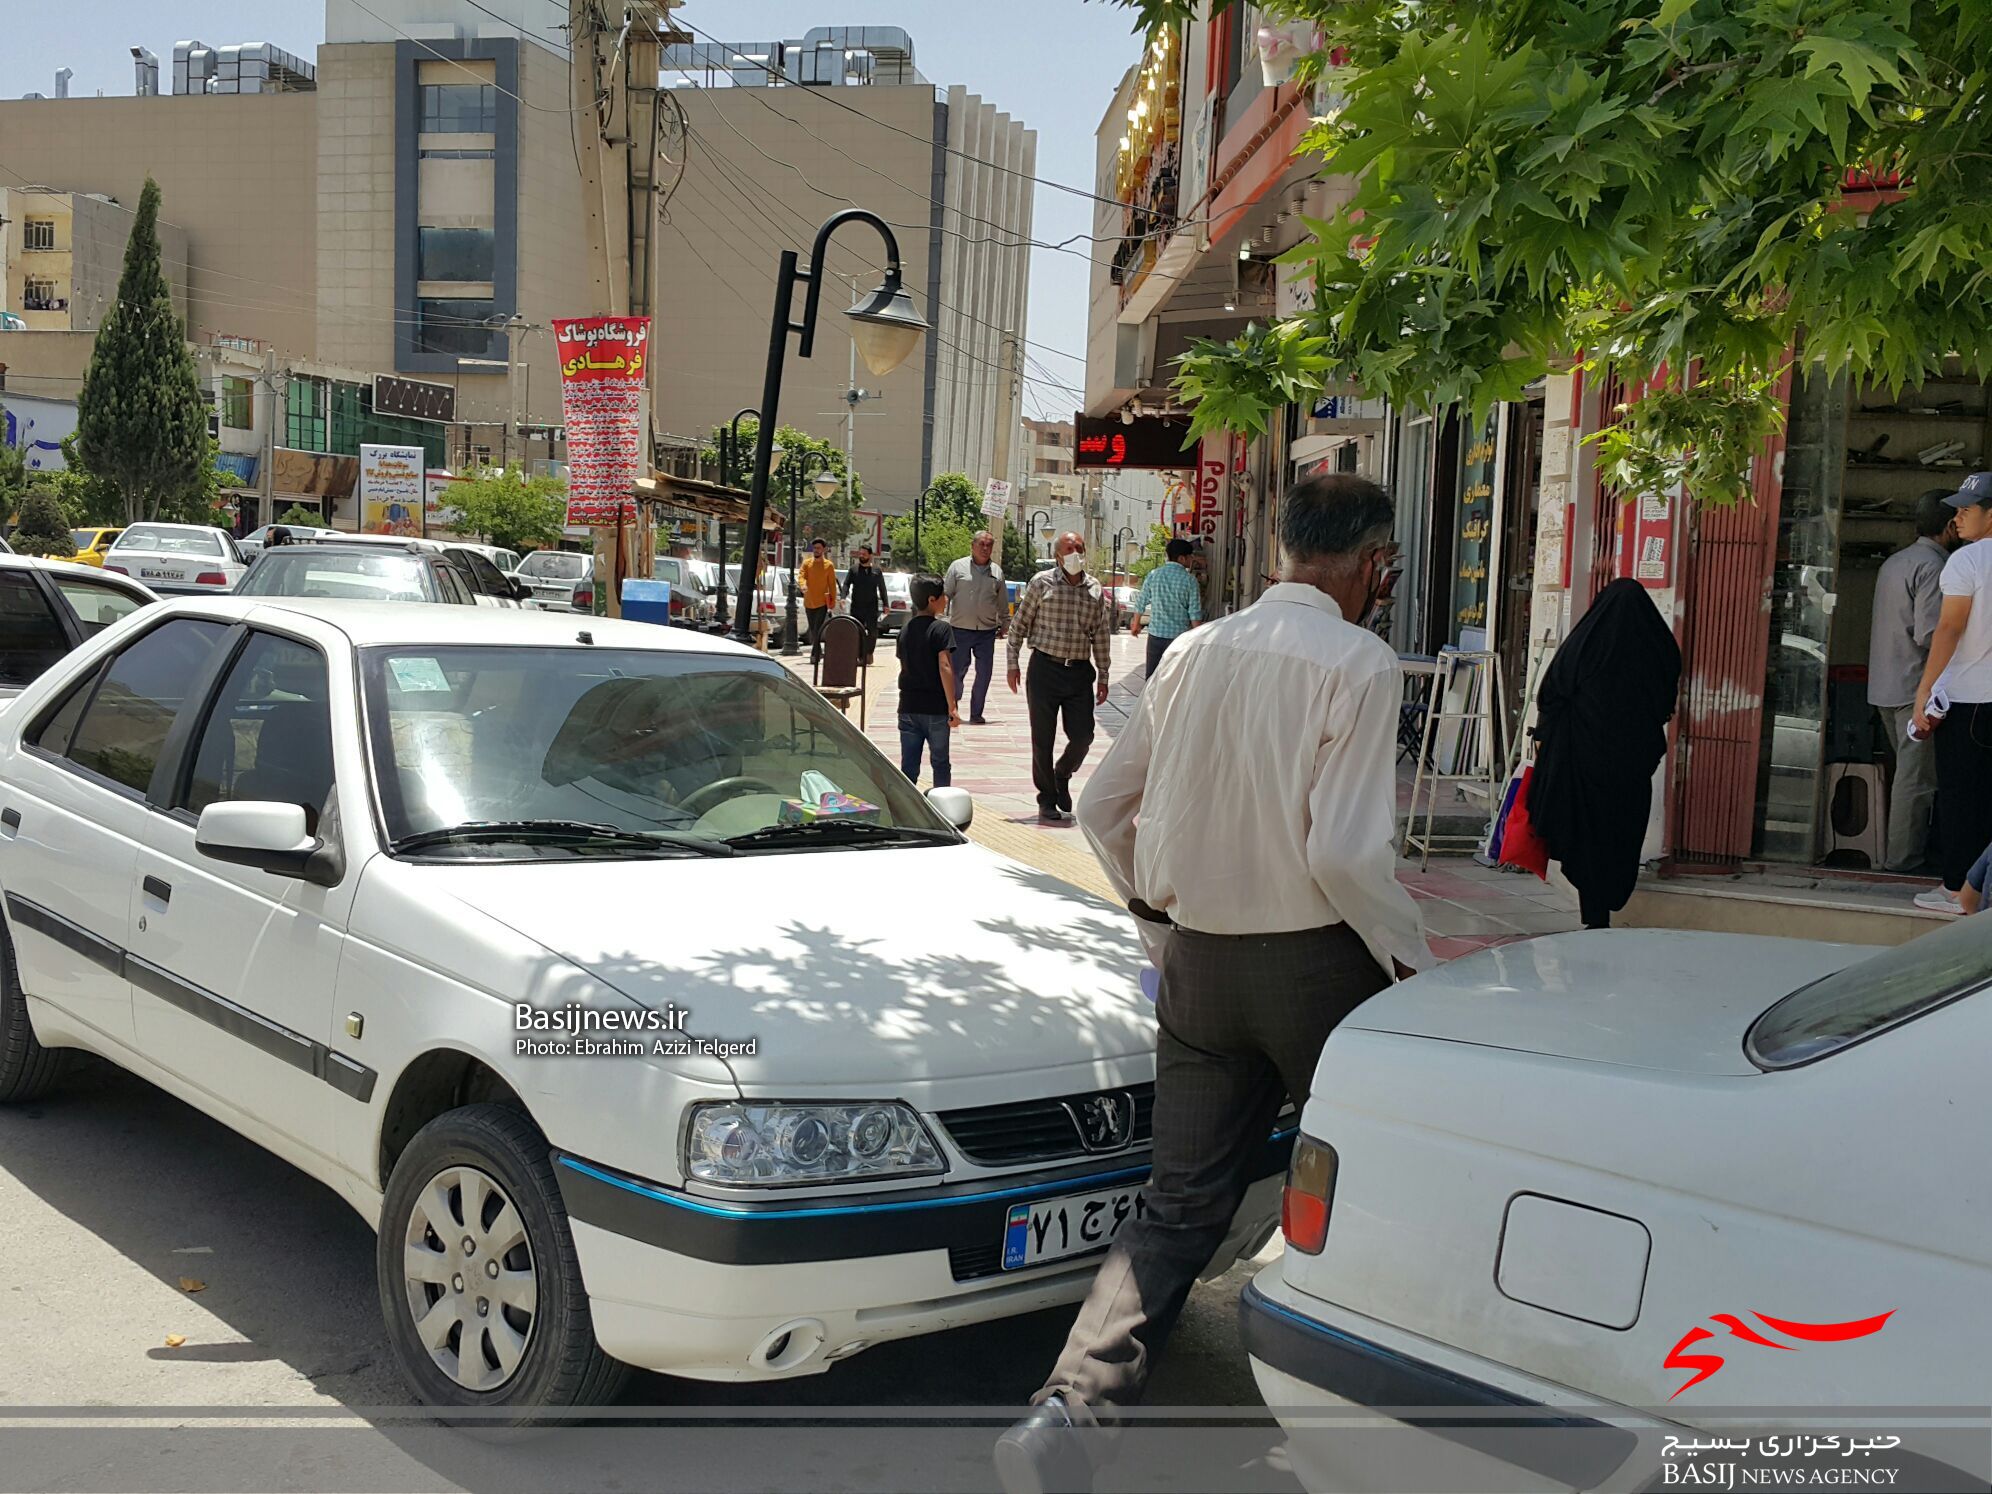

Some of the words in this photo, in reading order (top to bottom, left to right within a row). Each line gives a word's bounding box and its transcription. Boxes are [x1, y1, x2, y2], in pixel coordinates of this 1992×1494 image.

[558, 323, 598, 348] پوشاک
[598, 321, 646, 347] فروشگاه
[562, 349, 643, 377] فرهادی
[1006, 1254, 1024, 1264] IRAN
